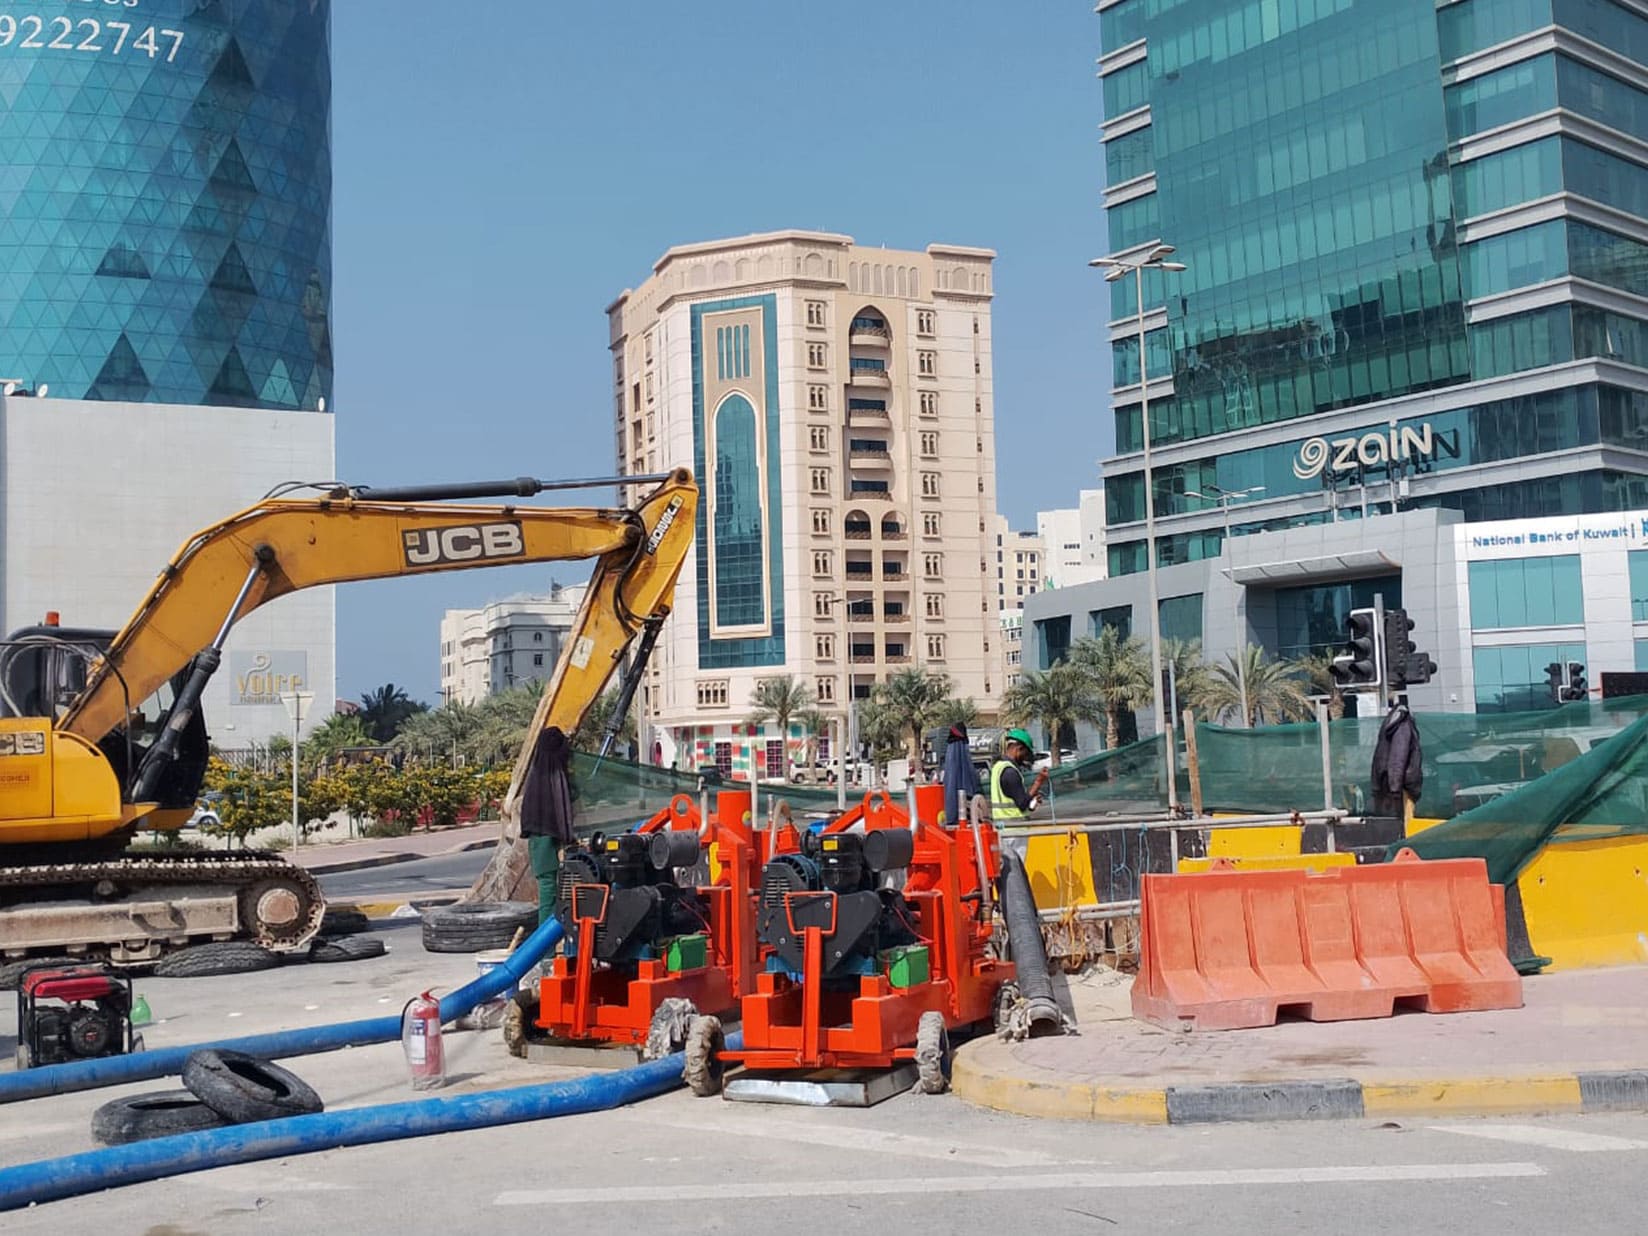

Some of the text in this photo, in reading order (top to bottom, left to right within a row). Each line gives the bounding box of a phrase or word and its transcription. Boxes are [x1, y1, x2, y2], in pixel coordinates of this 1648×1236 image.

[0, 15, 185, 62] 9222747
[405, 523, 522, 563] JCB
[1472, 533, 1526, 548] National
[1529, 530, 1563, 544] Bank
[1565, 528, 1580, 541] of
[1583, 525, 1628, 540] Kuwait
